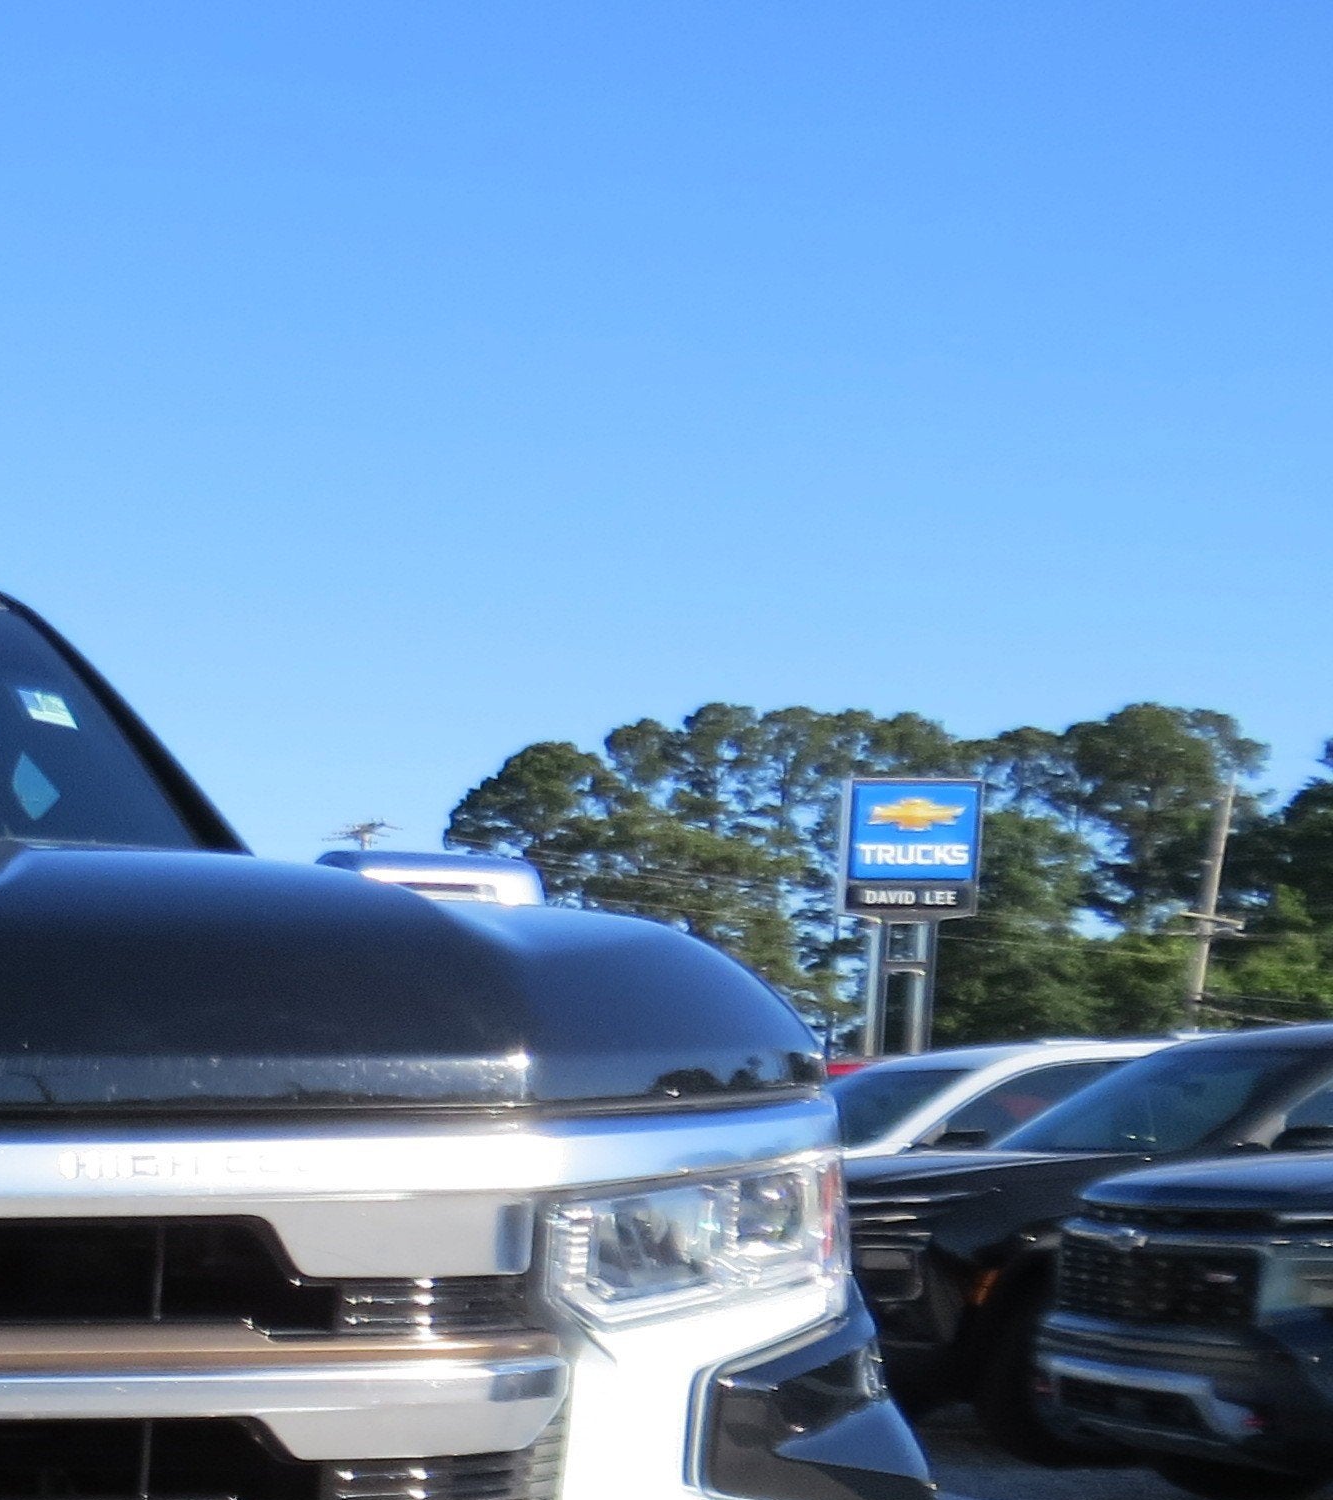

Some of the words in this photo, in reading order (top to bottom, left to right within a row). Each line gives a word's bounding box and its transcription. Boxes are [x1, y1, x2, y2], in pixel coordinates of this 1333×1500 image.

[857, 843, 969, 866] TRUCKS
[864, 890, 916, 906] DAVID
[924, 890, 958, 906] LEE
